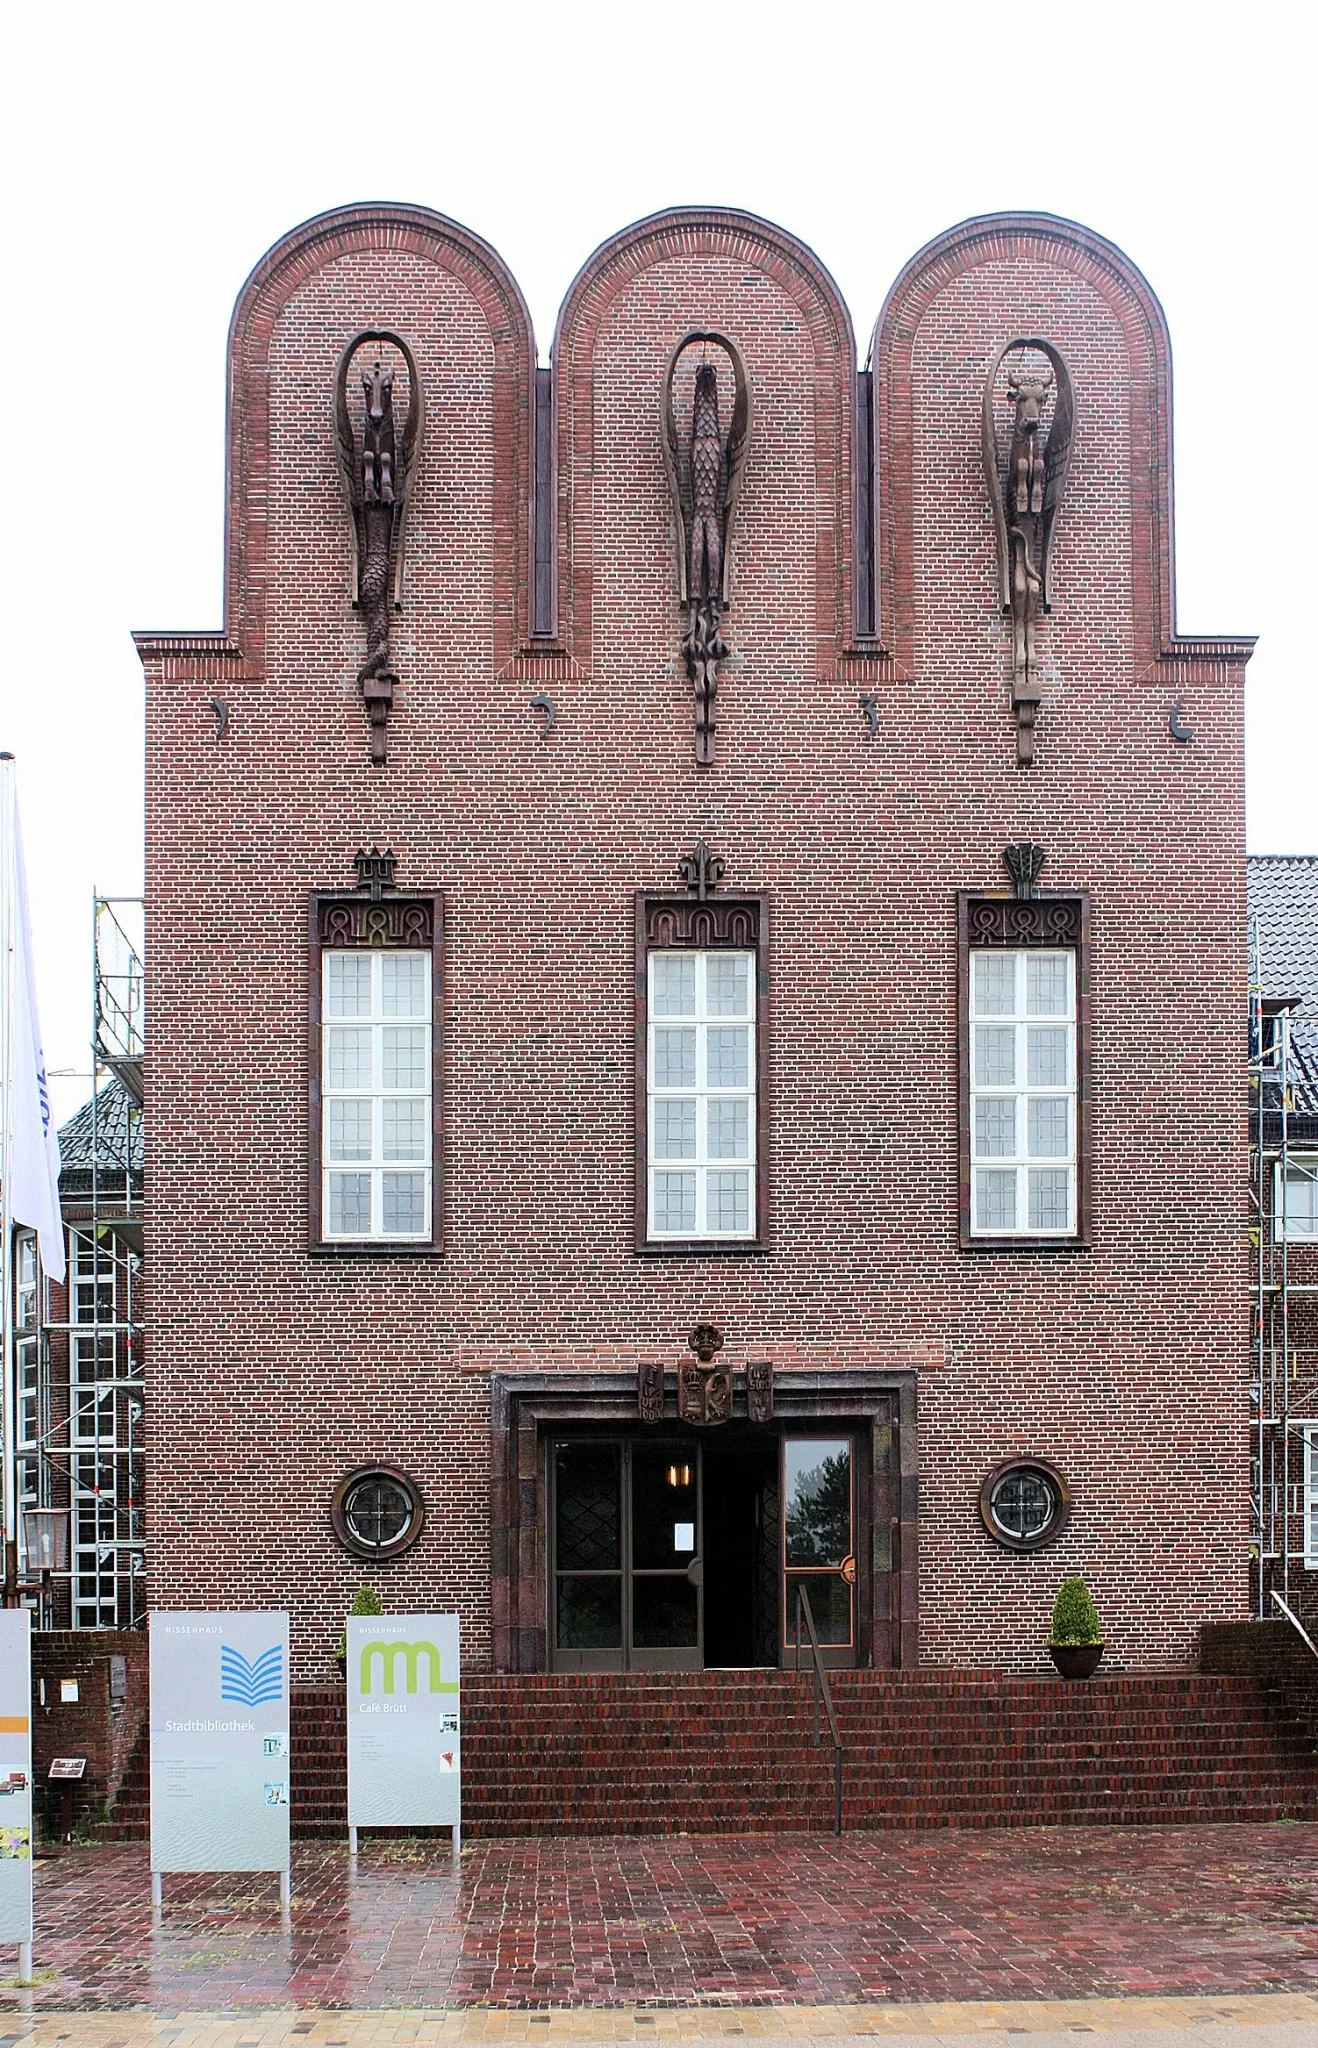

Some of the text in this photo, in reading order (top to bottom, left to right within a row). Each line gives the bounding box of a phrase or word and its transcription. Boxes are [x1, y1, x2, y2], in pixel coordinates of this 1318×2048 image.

[165, 1626, 223, 1634] NISSENHAUS
[359, 1702, 408, 1713] Café Brütt
[165, 1720, 255, 1732] Stadtbibliothek
